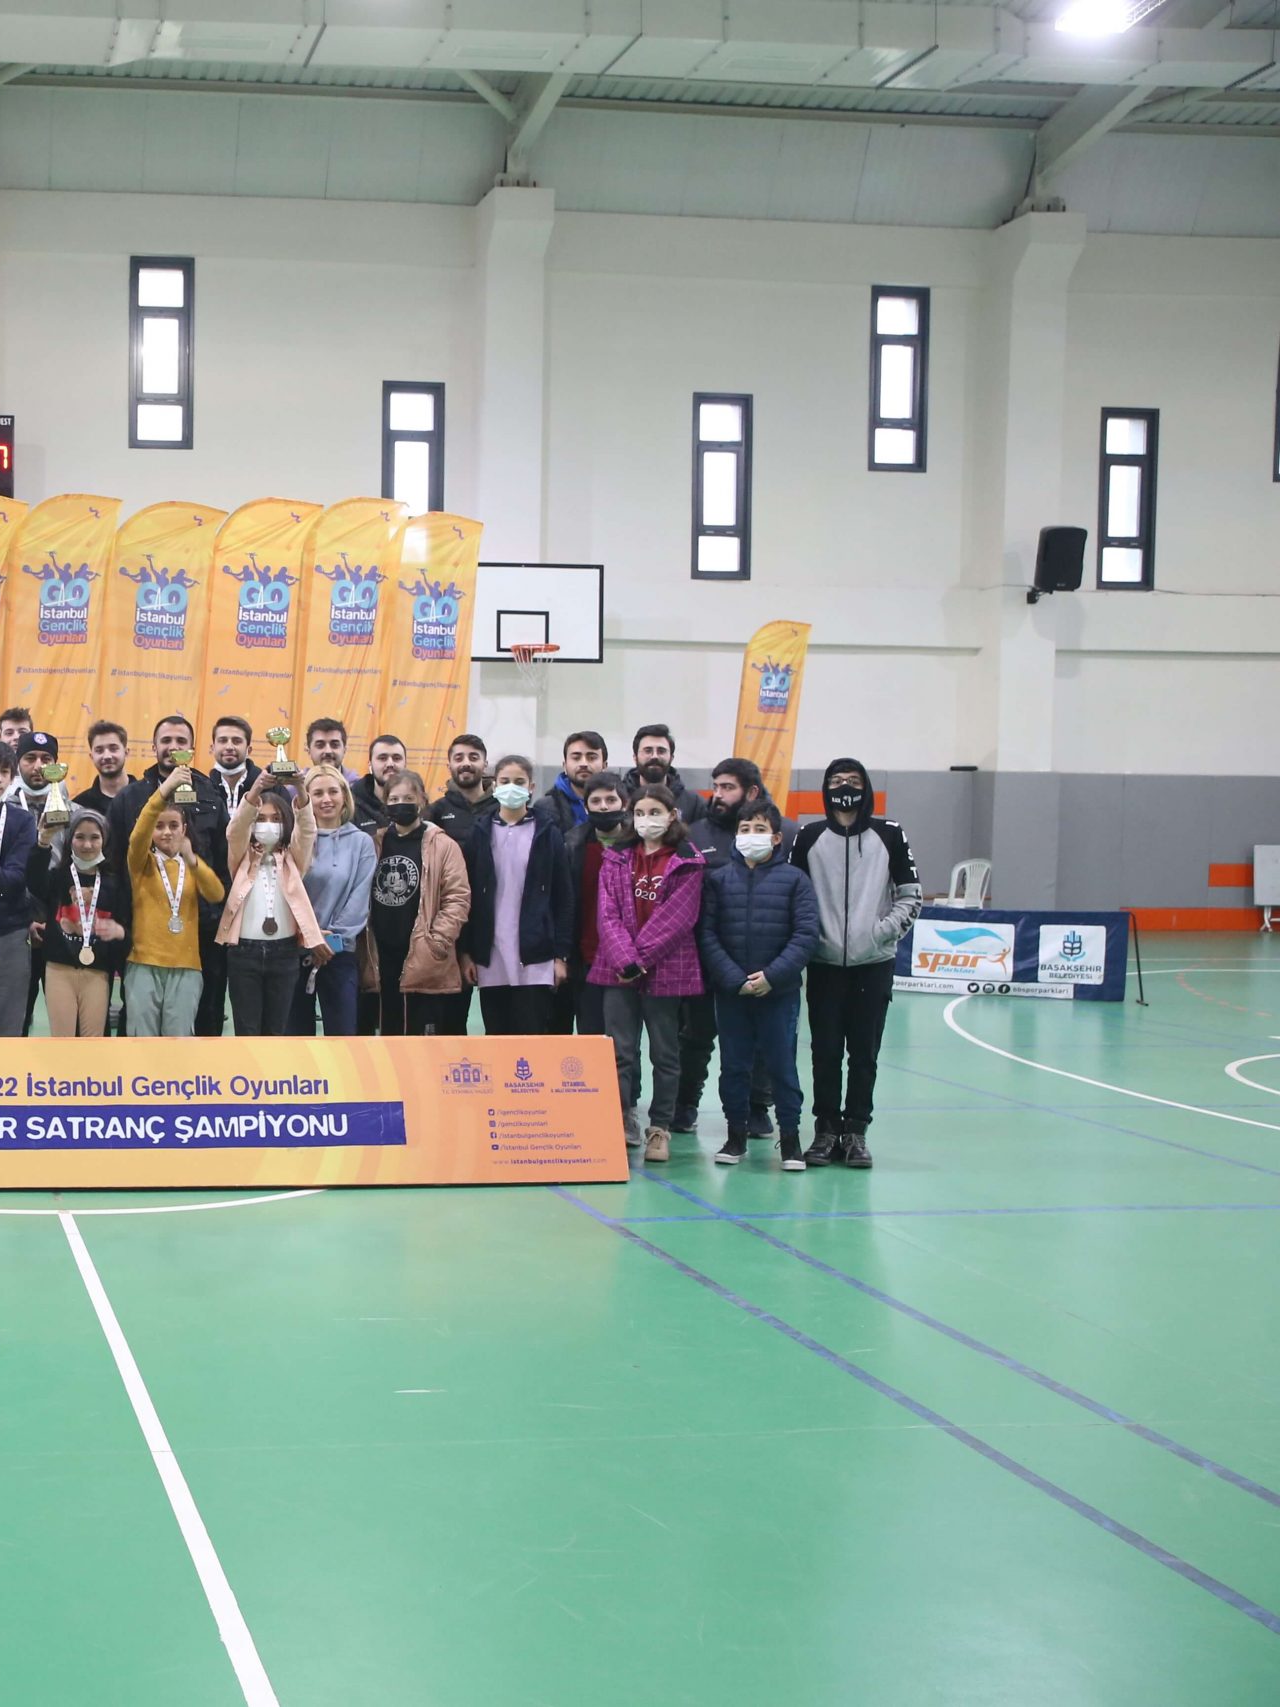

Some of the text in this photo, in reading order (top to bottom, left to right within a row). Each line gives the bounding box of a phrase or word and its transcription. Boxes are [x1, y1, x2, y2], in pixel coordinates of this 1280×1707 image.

[40, 578, 90, 607] GO
[136, 581, 188, 613] GO
[239, 580, 290, 611] GO
[332, 579, 378, 609] GO
[40, 605, 87, 619] İstanbul
[136, 608, 185, 625] İstanbul
[239, 606, 287, 623] İstanbul
[331, 605, 376, 620] İstanbul
[413, 595, 459, 624] GO
[39, 620, 87, 634] Gençlik
[135, 624, 185, 640] Gençlik
[238, 621, 287, 637] Gençlik
[330, 620, 374, 635] Gençlik
[413, 620, 456, 635] İstanbul
[413, 635, 456, 648] Gençlik
[634, 888, 657, 900] 020
[26, 1073, 122, 1097] İstanbul
[131, 1075, 222, 1100] Gençlik
[230, 1075, 329, 1100] Oyunları
[26, 1116, 165, 1144] SATRANÇ
[174, 1110, 349, 1144] ŞAMPİYONU
